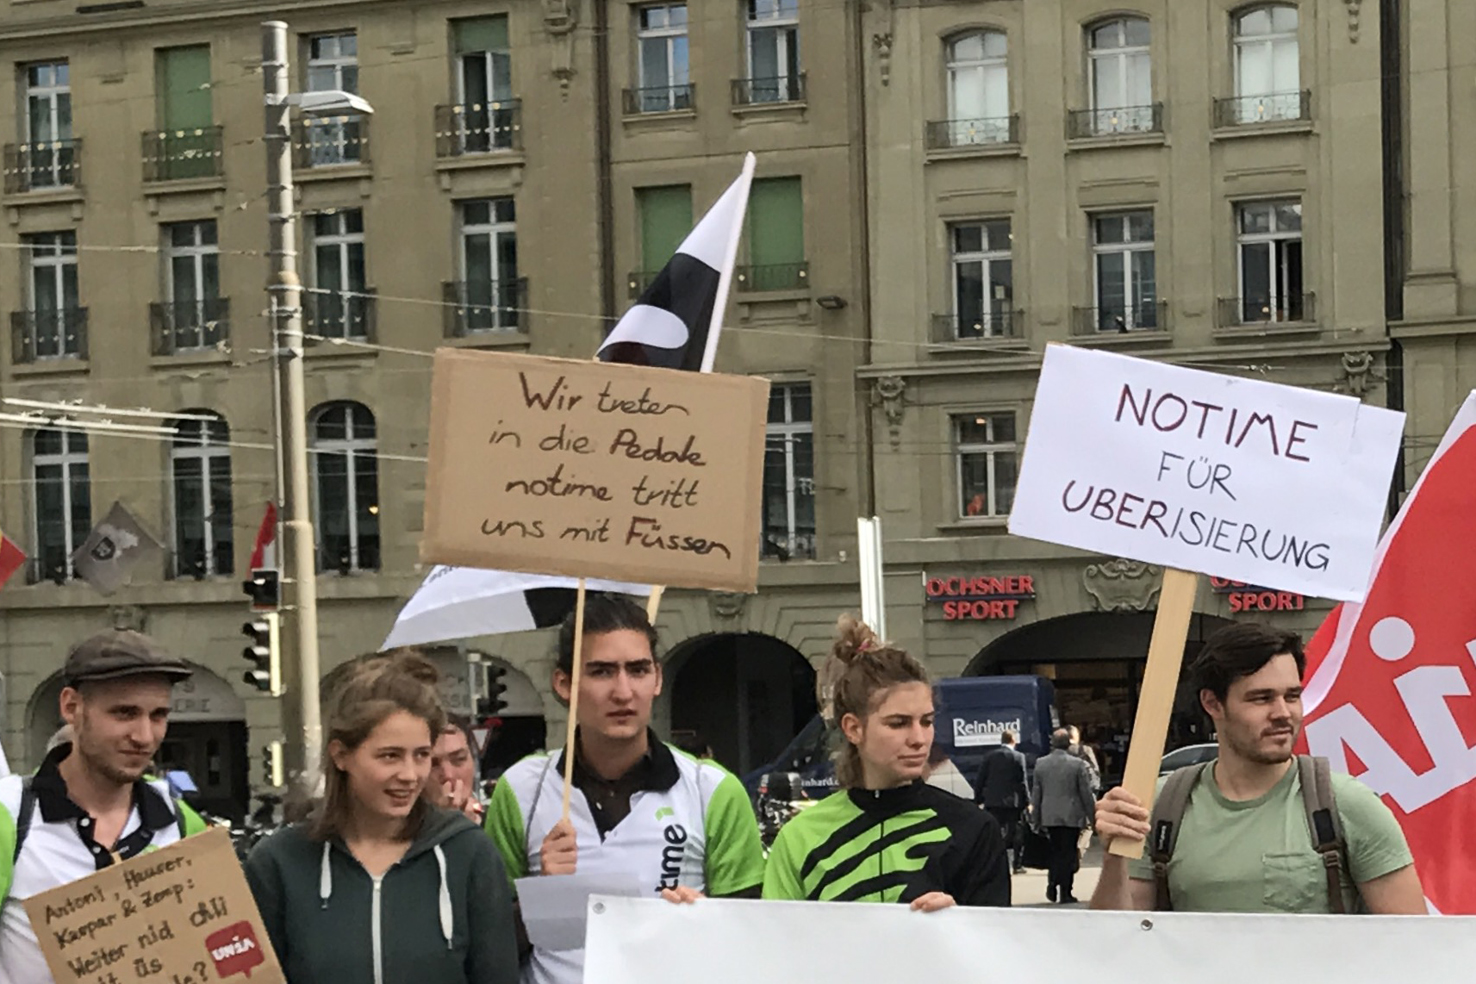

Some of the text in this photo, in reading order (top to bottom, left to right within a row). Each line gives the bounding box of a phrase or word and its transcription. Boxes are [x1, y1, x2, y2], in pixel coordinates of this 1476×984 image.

[518, 371, 584, 411] Wir
[488, 420, 522, 449] in
[538, 423, 597, 454] die
[1114, 383, 1319, 463] NOTIME
[504, 463, 701, 509] notime tritt
[1156, 450, 1237, 501] FÜR
[480, 515, 732, 560] uns mit Füssen
[1061, 479, 1331, 572] UBERISIERUNG
[925, 574, 1036, 597] OCHSNER
[942, 599, 1020, 621] SPORT
[952, 717, 1021, 737] Reinhard
[120, 898, 138, 919] &
[67, 943, 129, 979] Weiter
[137, 919, 175, 949] nid
